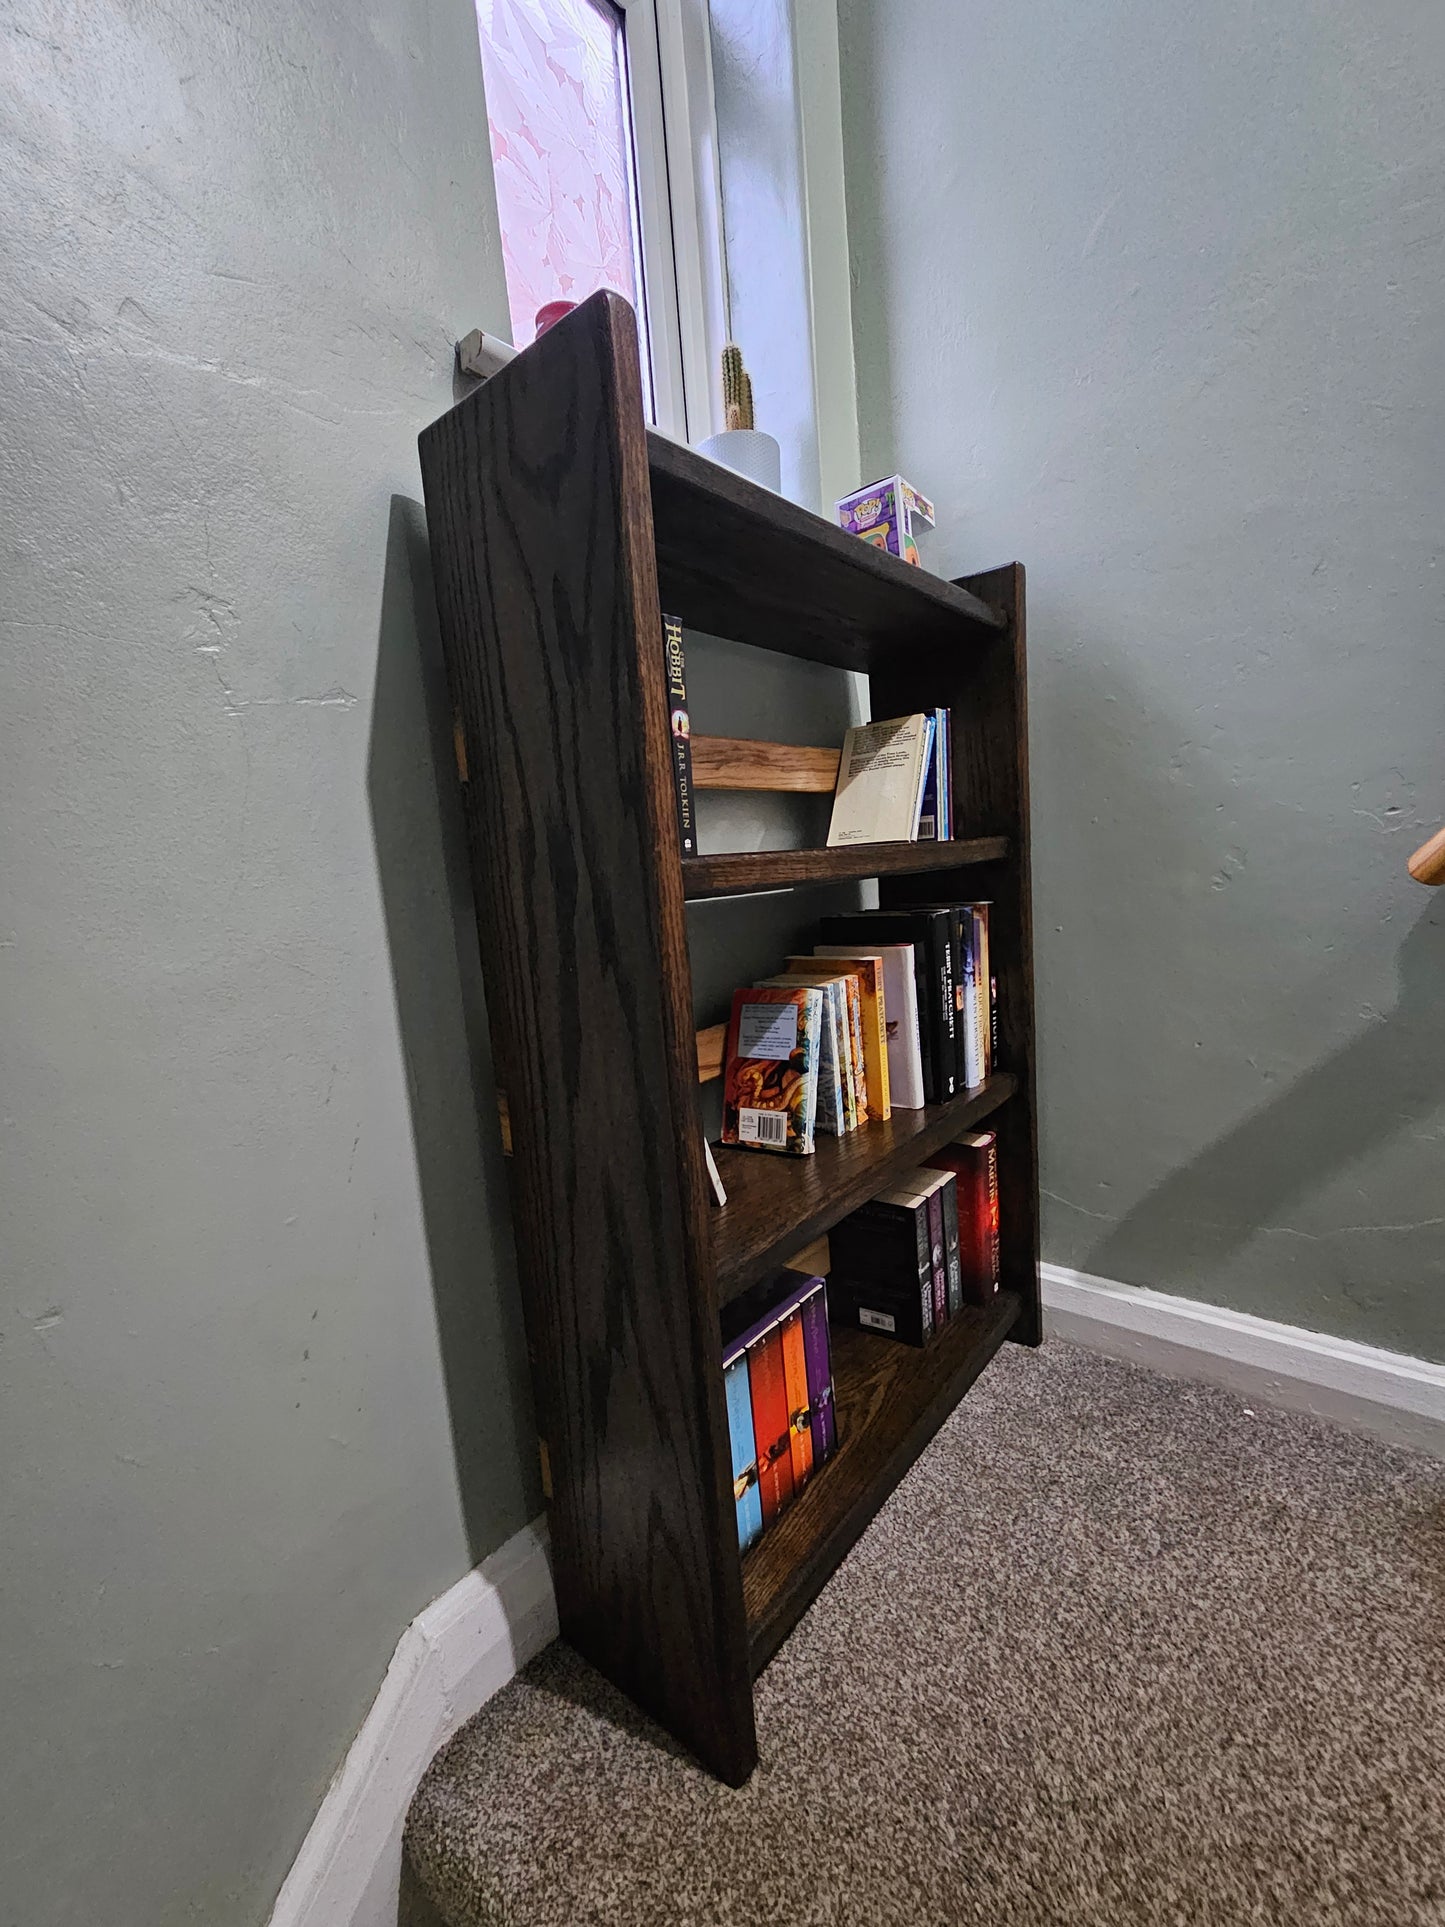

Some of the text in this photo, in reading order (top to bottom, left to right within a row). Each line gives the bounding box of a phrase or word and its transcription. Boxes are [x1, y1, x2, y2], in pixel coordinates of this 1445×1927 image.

[854, 498, 880, 520] POP!
[665, 622, 686, 701] HOBBIT
[680, 775, 690, 829] TOLKIEN
[878, 996, 886, 1044] PRATCHETT
[947, 979, 955, 1039] PRATCHETT
[987, 1148, 996, 1204] MARTIN
